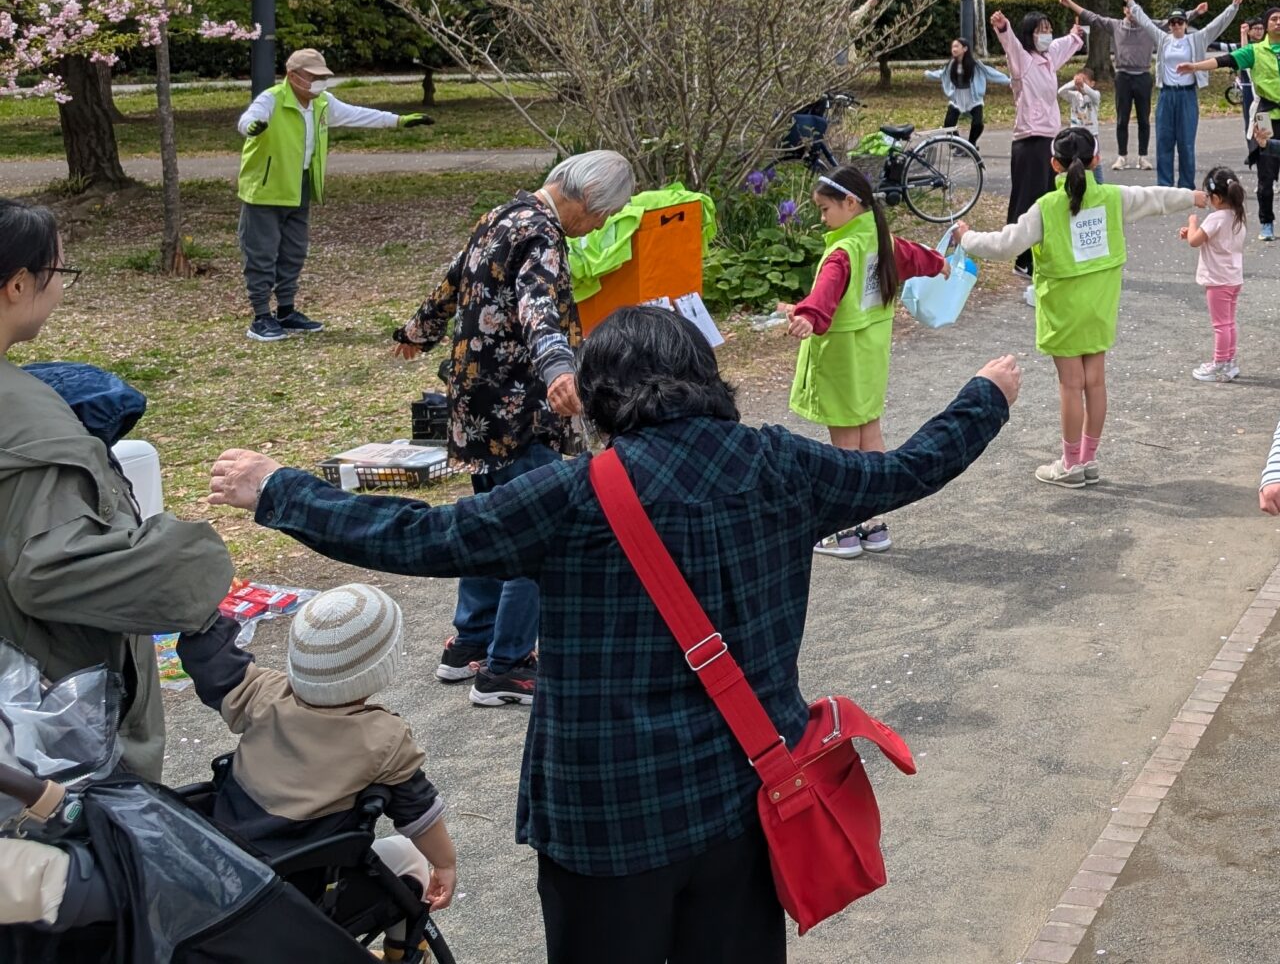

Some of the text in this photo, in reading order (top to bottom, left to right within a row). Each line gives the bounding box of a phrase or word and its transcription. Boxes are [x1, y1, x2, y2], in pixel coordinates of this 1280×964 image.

[1076, 217, 1103, 228] GREEN
[1079, 230, 1101, 239] EXPO
[1080, 236, 1101, 246] 2027
